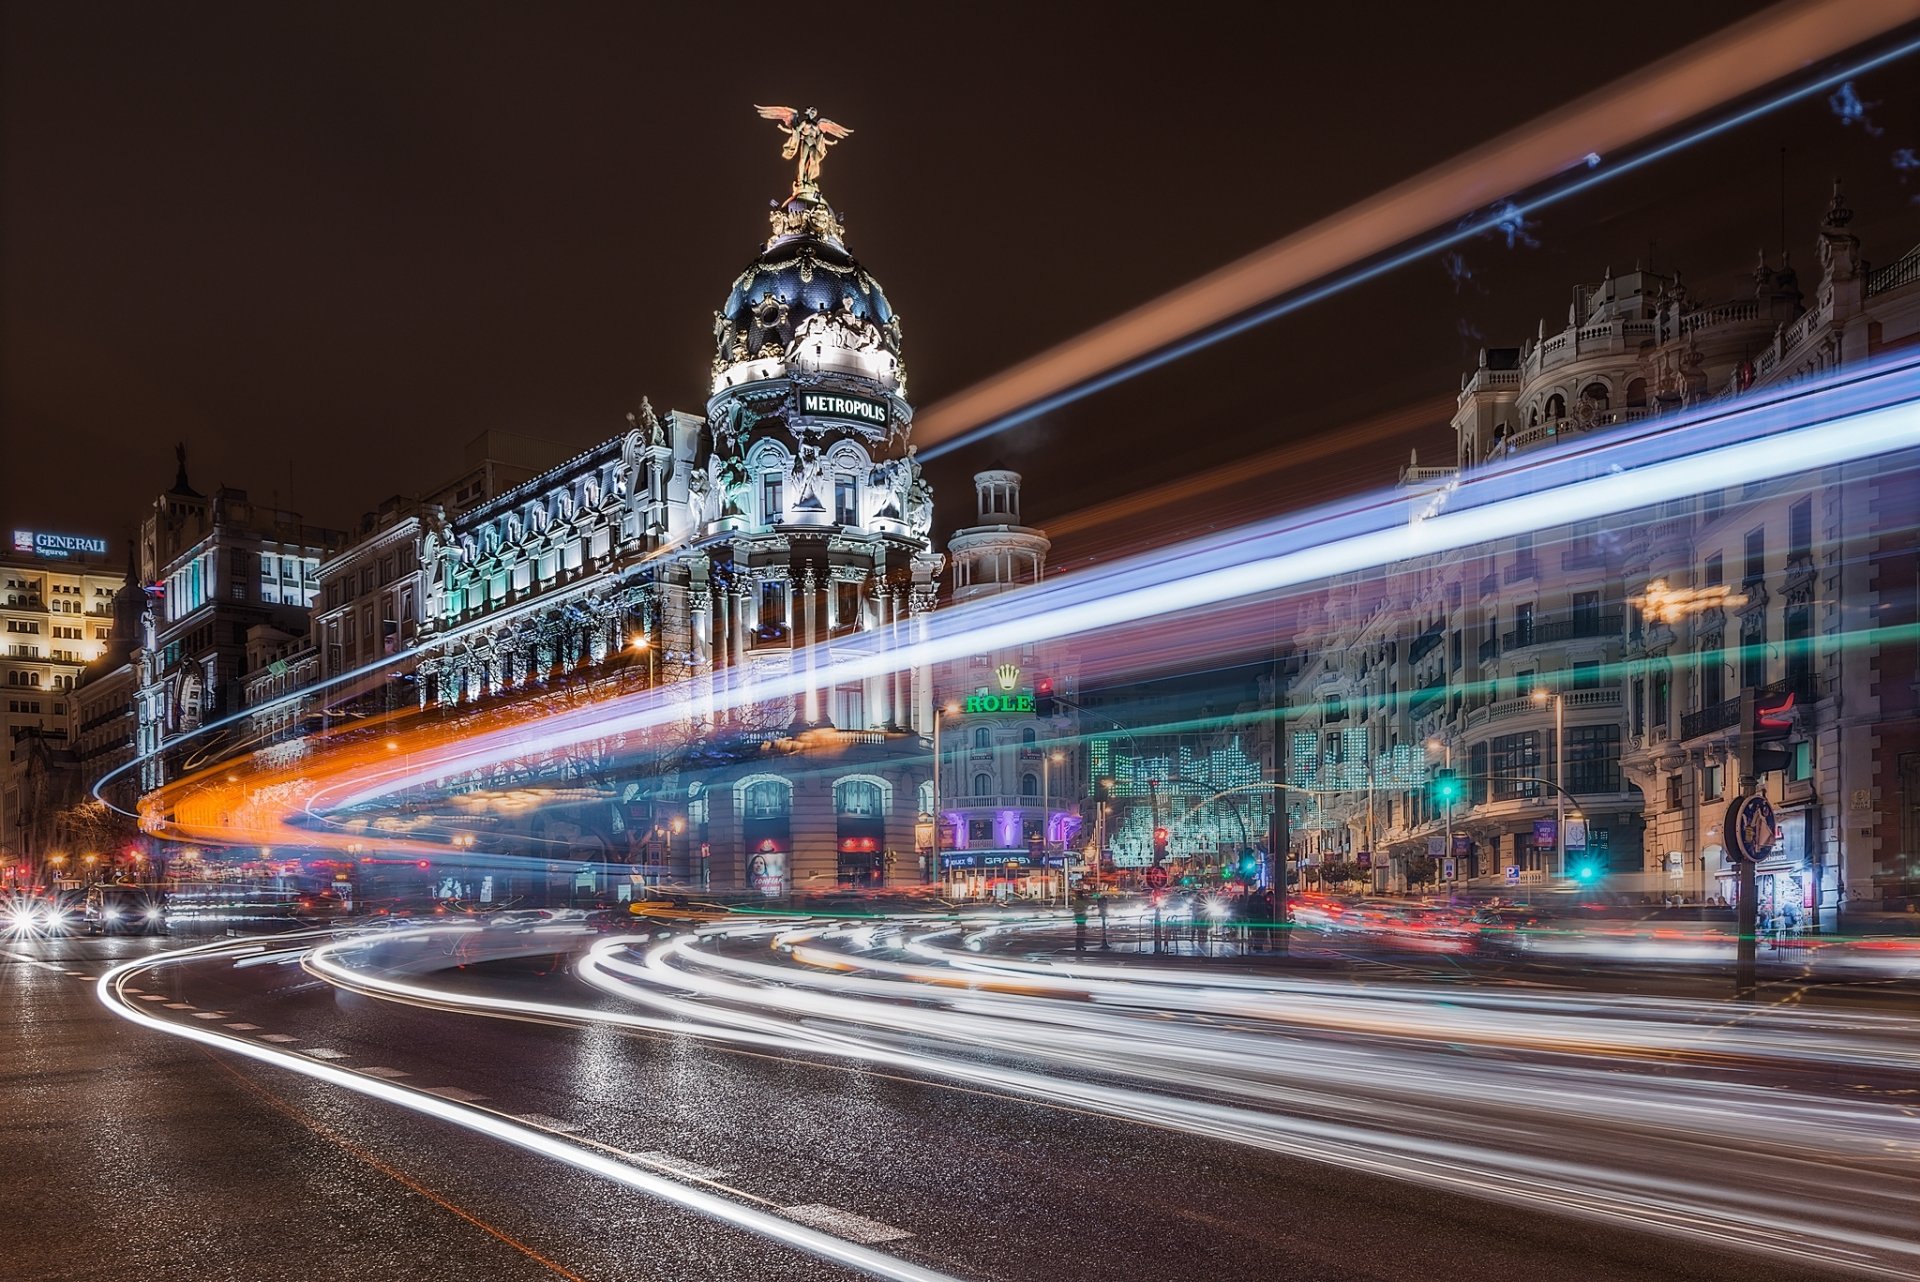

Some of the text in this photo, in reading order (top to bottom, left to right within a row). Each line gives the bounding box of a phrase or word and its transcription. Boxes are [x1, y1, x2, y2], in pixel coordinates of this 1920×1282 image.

[805, 395, 886, 422] METROPOLIS
[36, 534, 106, 552] GENERALI
[36, 546, 68, 556] Seguros
[966, 695, 1037, 713] ROLE
